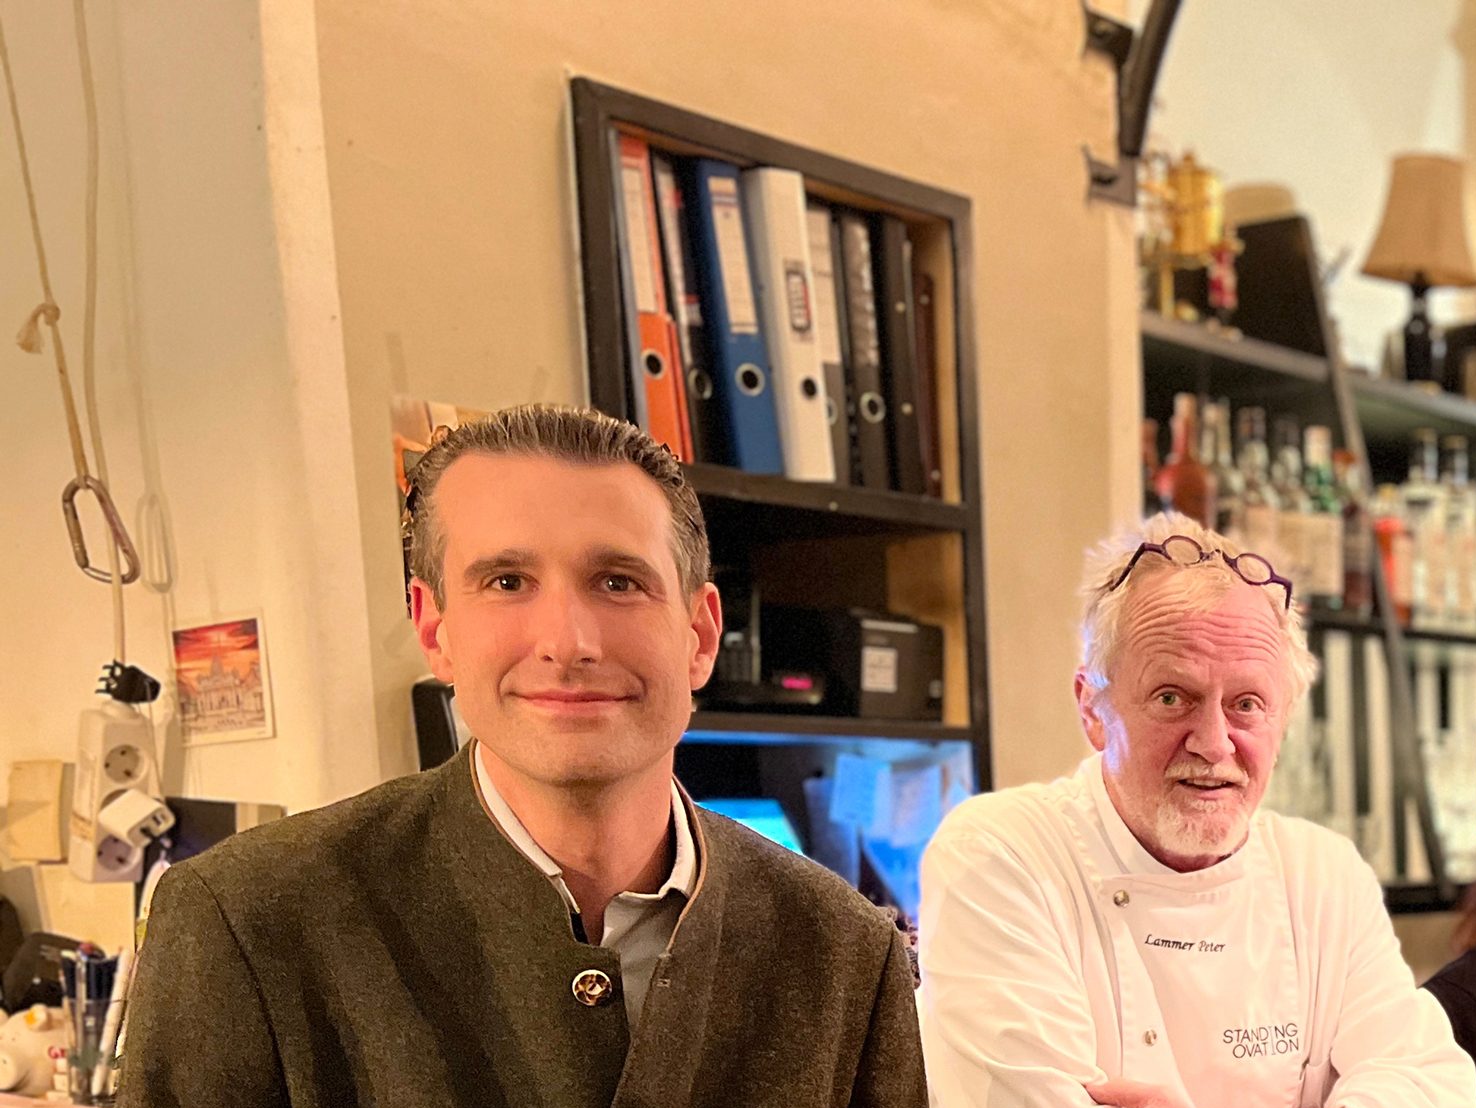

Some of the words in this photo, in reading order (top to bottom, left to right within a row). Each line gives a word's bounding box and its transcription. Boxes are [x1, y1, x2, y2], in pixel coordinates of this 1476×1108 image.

[1144, 934, 1194, 951] Lammer
[1199, 940, 1225, 953] Peter
[1223, 1023, 1298, 1044] STANDING
[1232, 1037, 1299, 1058] OVATION
